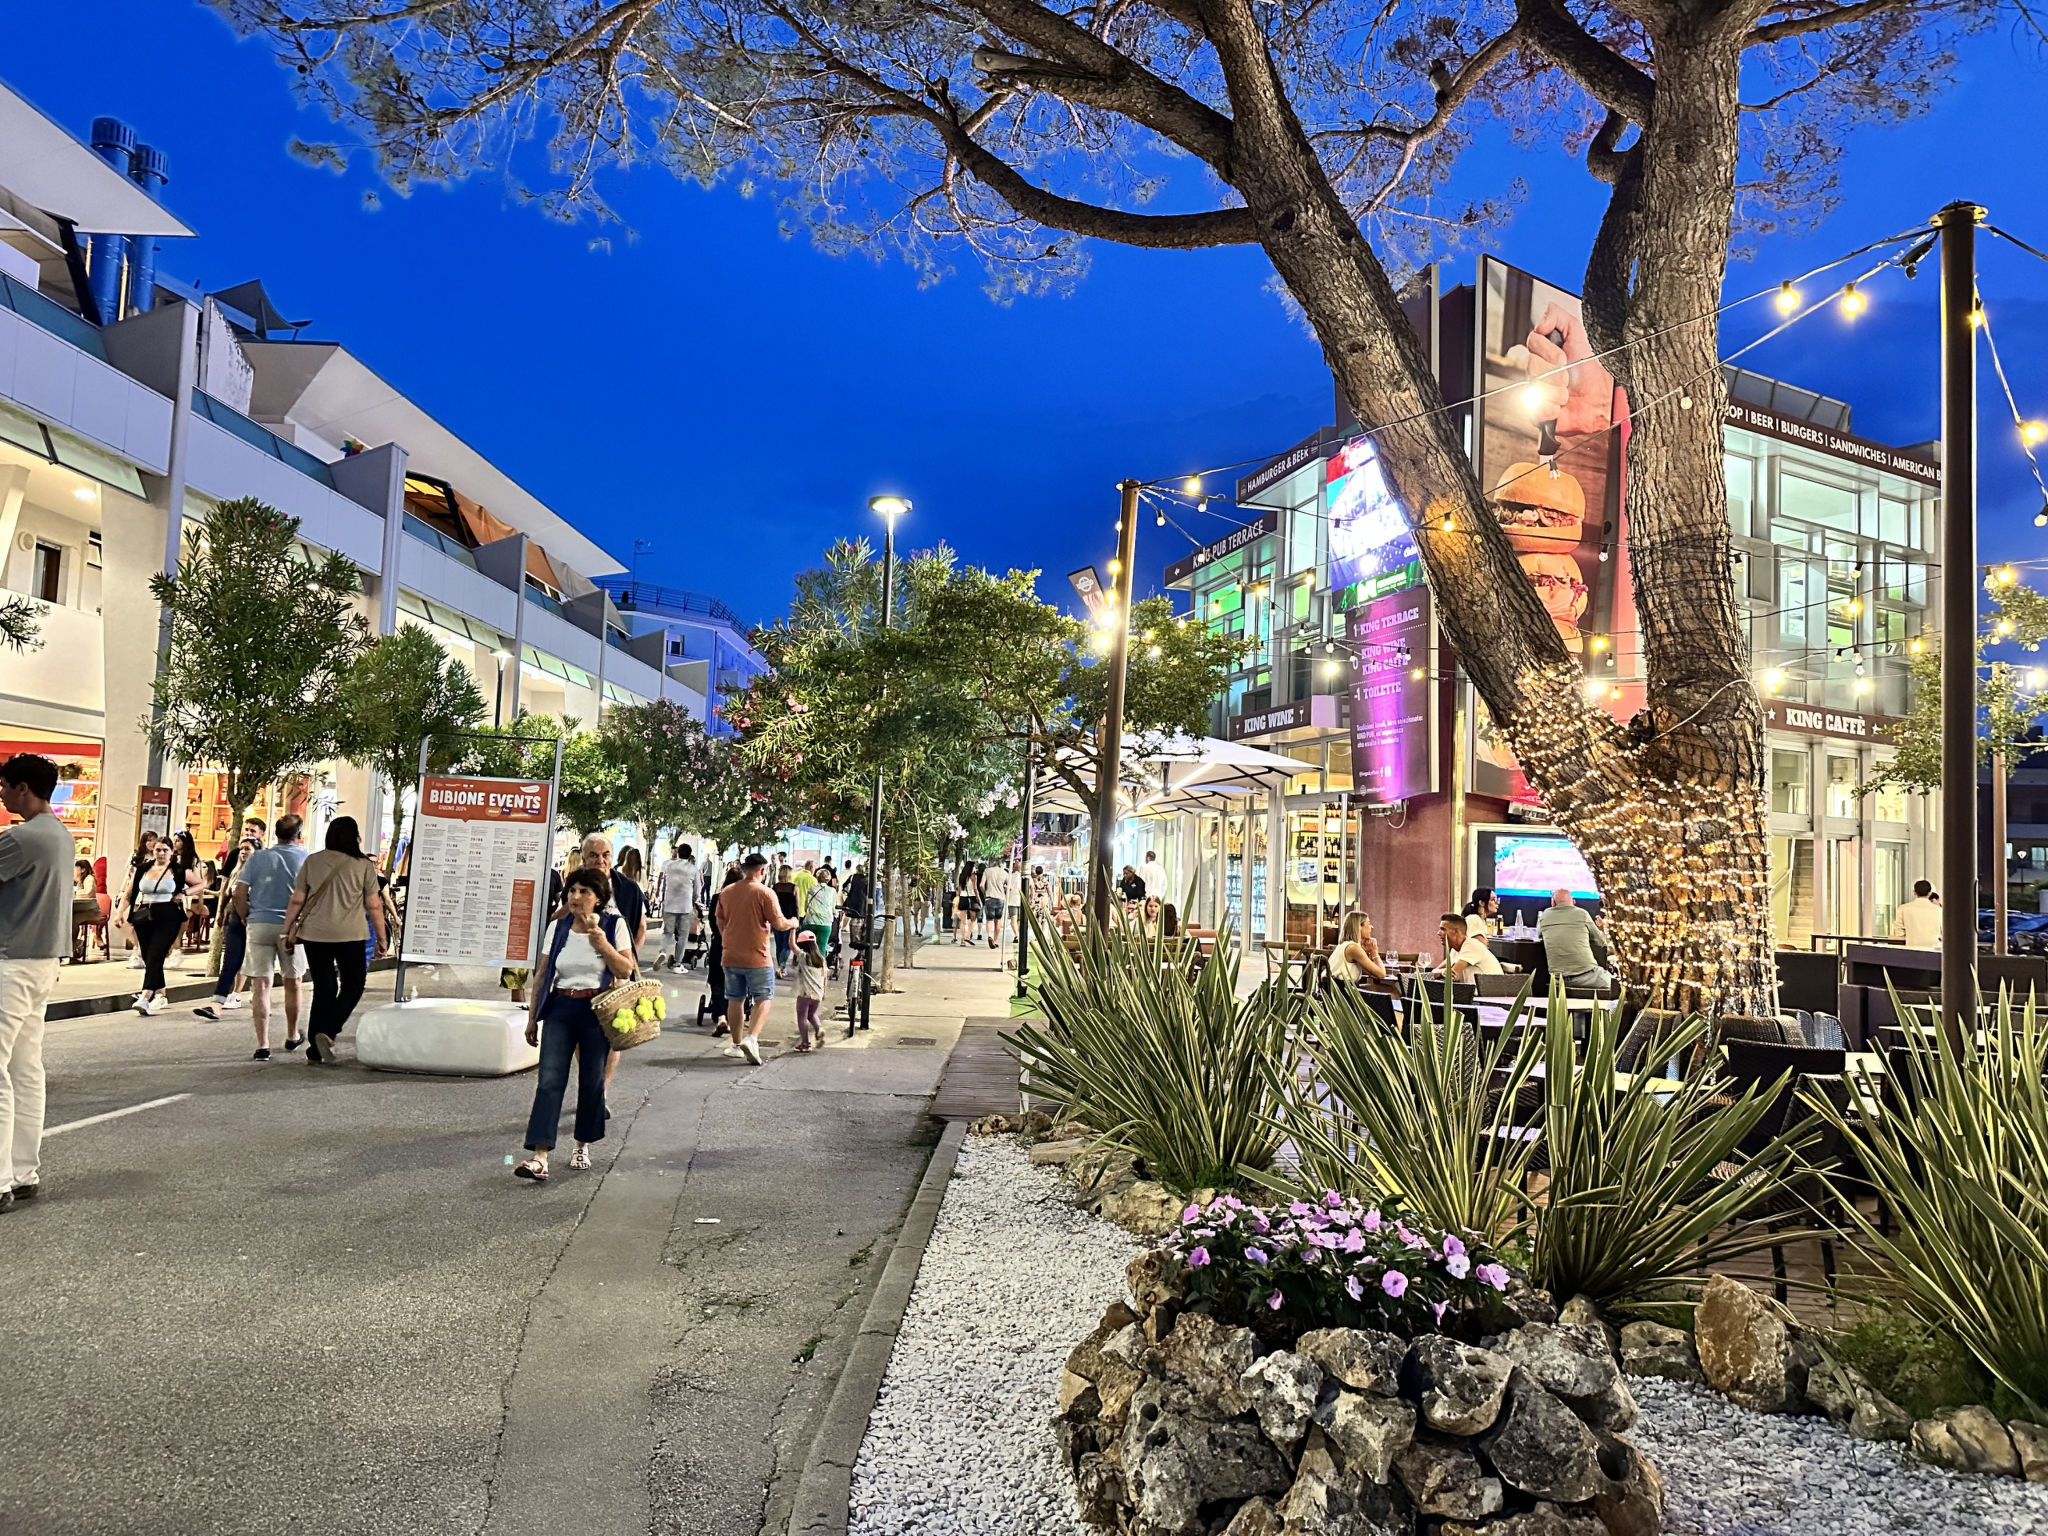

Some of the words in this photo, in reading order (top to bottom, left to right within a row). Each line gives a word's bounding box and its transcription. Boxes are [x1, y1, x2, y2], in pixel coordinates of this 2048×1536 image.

[1750, 410, 1774, 430] BEER
[1781, 420, 1824, 445] BURGERS
[1829, 436, 1886, 465] SANDWICHES
[1892, 456, 1935, 480] AMERICAN
[1936, 468, 1942, 481] B
[1247, 460, 1286, 493] HAMBURGER
[1292, 447, 1309, 466] BEER
[1212, 539, 1227, 558] PUB
[1227, 519, 1264, 550] TERRACE
[1353, 623, 1358, 638] 1
[1359, 619, 1380, 636] KING
[1381, 607, 1419, 629] TERRACE
[1361, 645, 1381, 660] KING
[1382, 637, 1406, 655] WINE
[1362, 661, 1382, 676] KING
[1363, 682, 1402, 700] TOILETTE
[1244, 715, 1266, 733] KING
[1268, 709, 1294, 728] WINE
[1786, 708, 1823, 730] KING
[1826, 715, 1866, 736] CAFFÈ
[430, 789, 486, 806] BIBIONE
[488, 793, 541, 809] EVENTS
